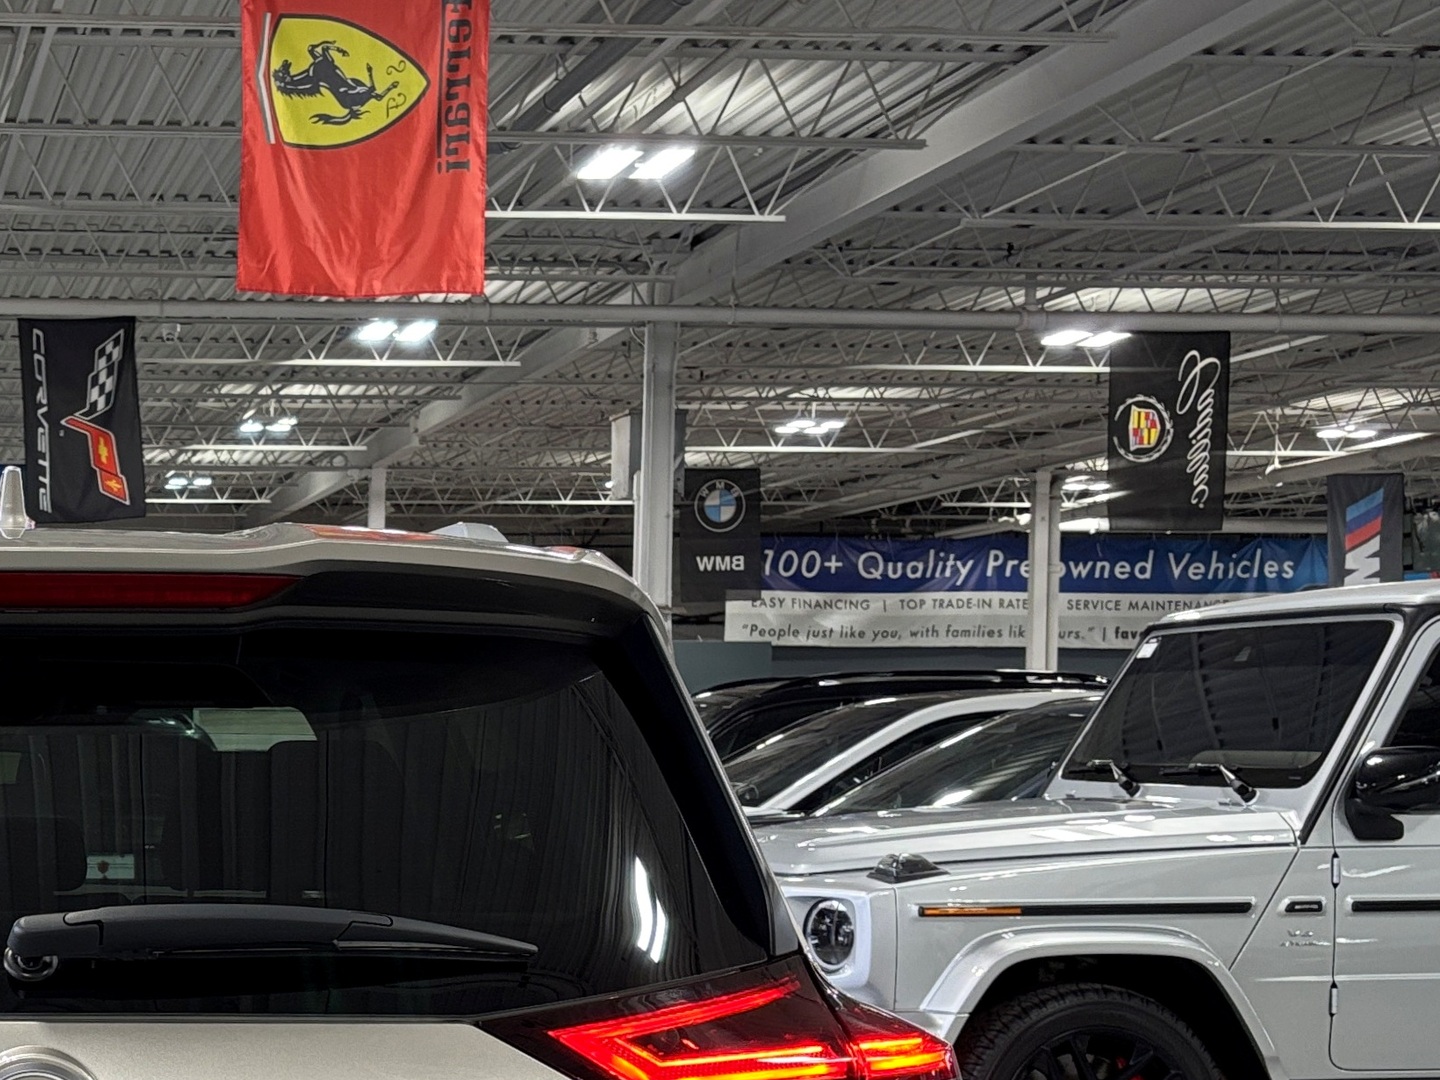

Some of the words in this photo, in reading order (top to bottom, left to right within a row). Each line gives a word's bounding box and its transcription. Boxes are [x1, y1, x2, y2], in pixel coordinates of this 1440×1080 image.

[32, 328, 52, 514] CORVETTE
[763, 549, 844, 579] 100+
[857, 548, 975, 586] Quality
[1168, 548, 1295, 580] Vehicles
[791, 597, 871, 611] FINANCING
[899, 598, 926, 610] TOP
[931, 597, 992, 610] TRADE-IN
[1067, 599, 1121, 611] SERVICE
[805, 625, 834, 641] just
[840, 624, 866, 639] like
[871, 629, 902, 642] you,
[909, 624, 939, 639] with
[945, 624, 1003, 639] families
[1008, 624, 1026, 639] lik
